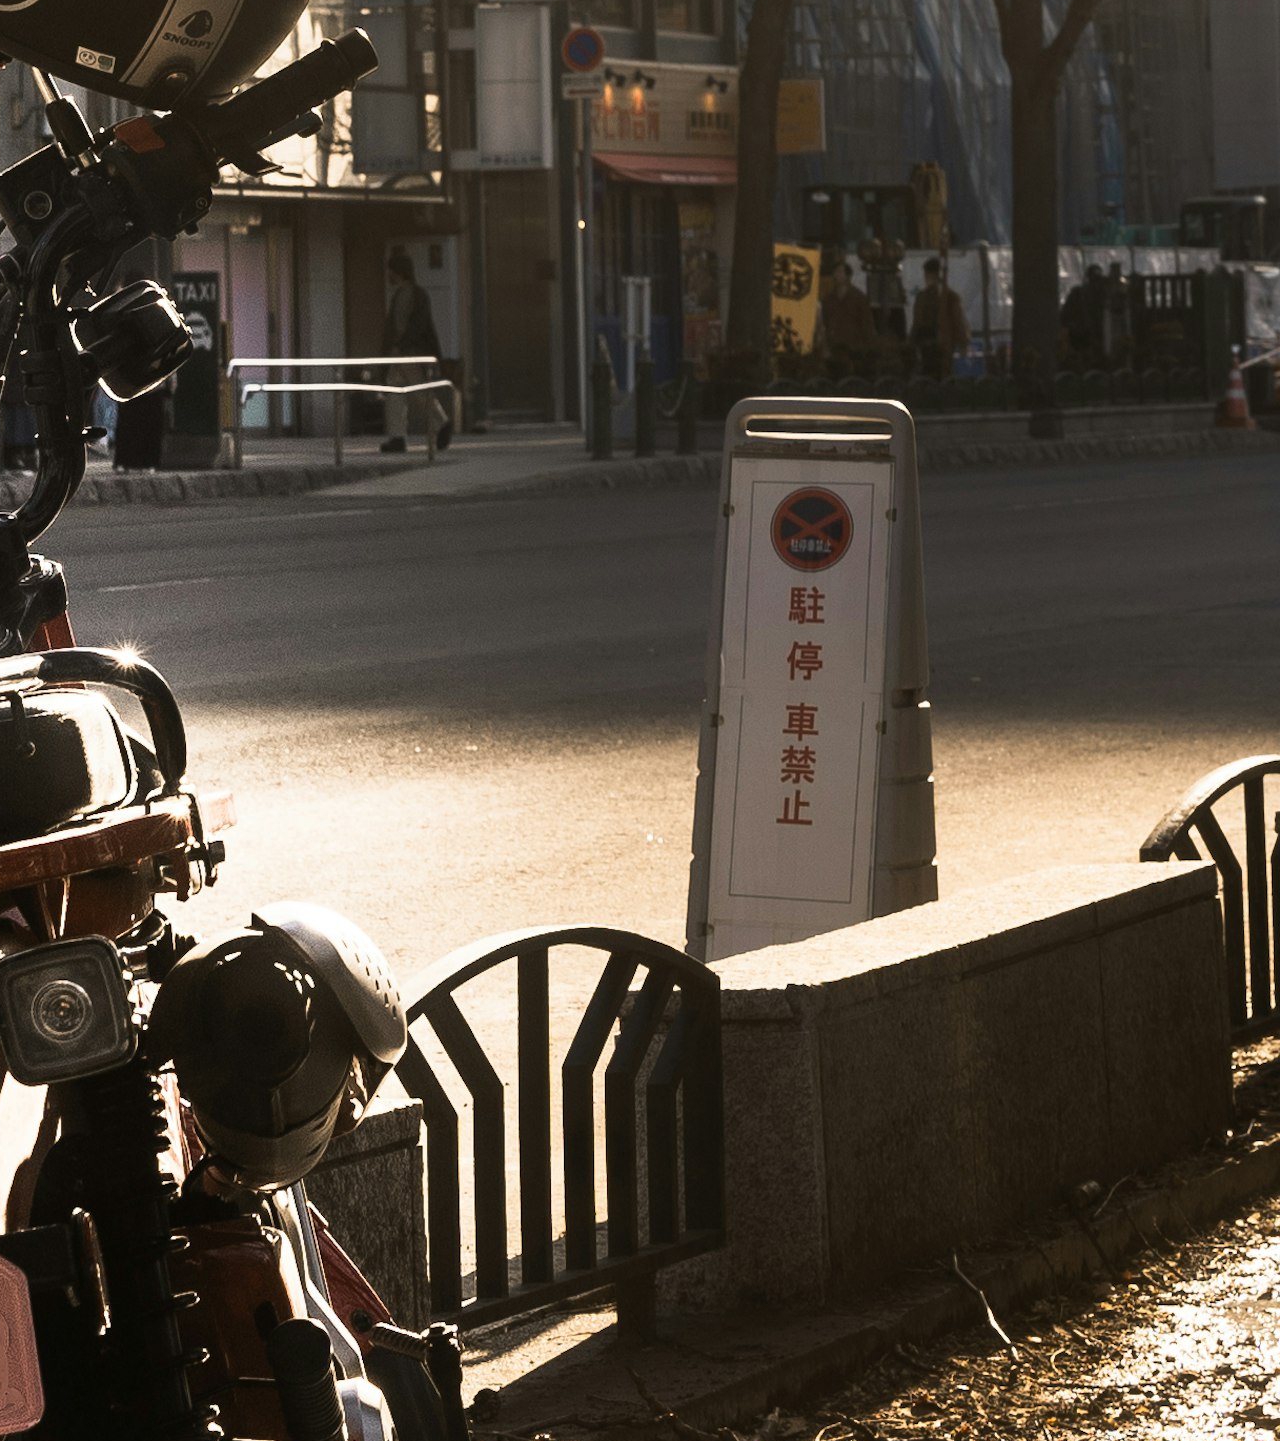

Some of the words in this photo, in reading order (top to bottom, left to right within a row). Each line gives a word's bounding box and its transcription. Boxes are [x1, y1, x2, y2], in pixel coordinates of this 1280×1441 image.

[162, 32, 214, 49] SNOOPY
[175, 282, 216, 301] TAXI
[791, 538, 832, 553] 駐停車禁止
[776, 585, 826, 827] 駐停車禁止
